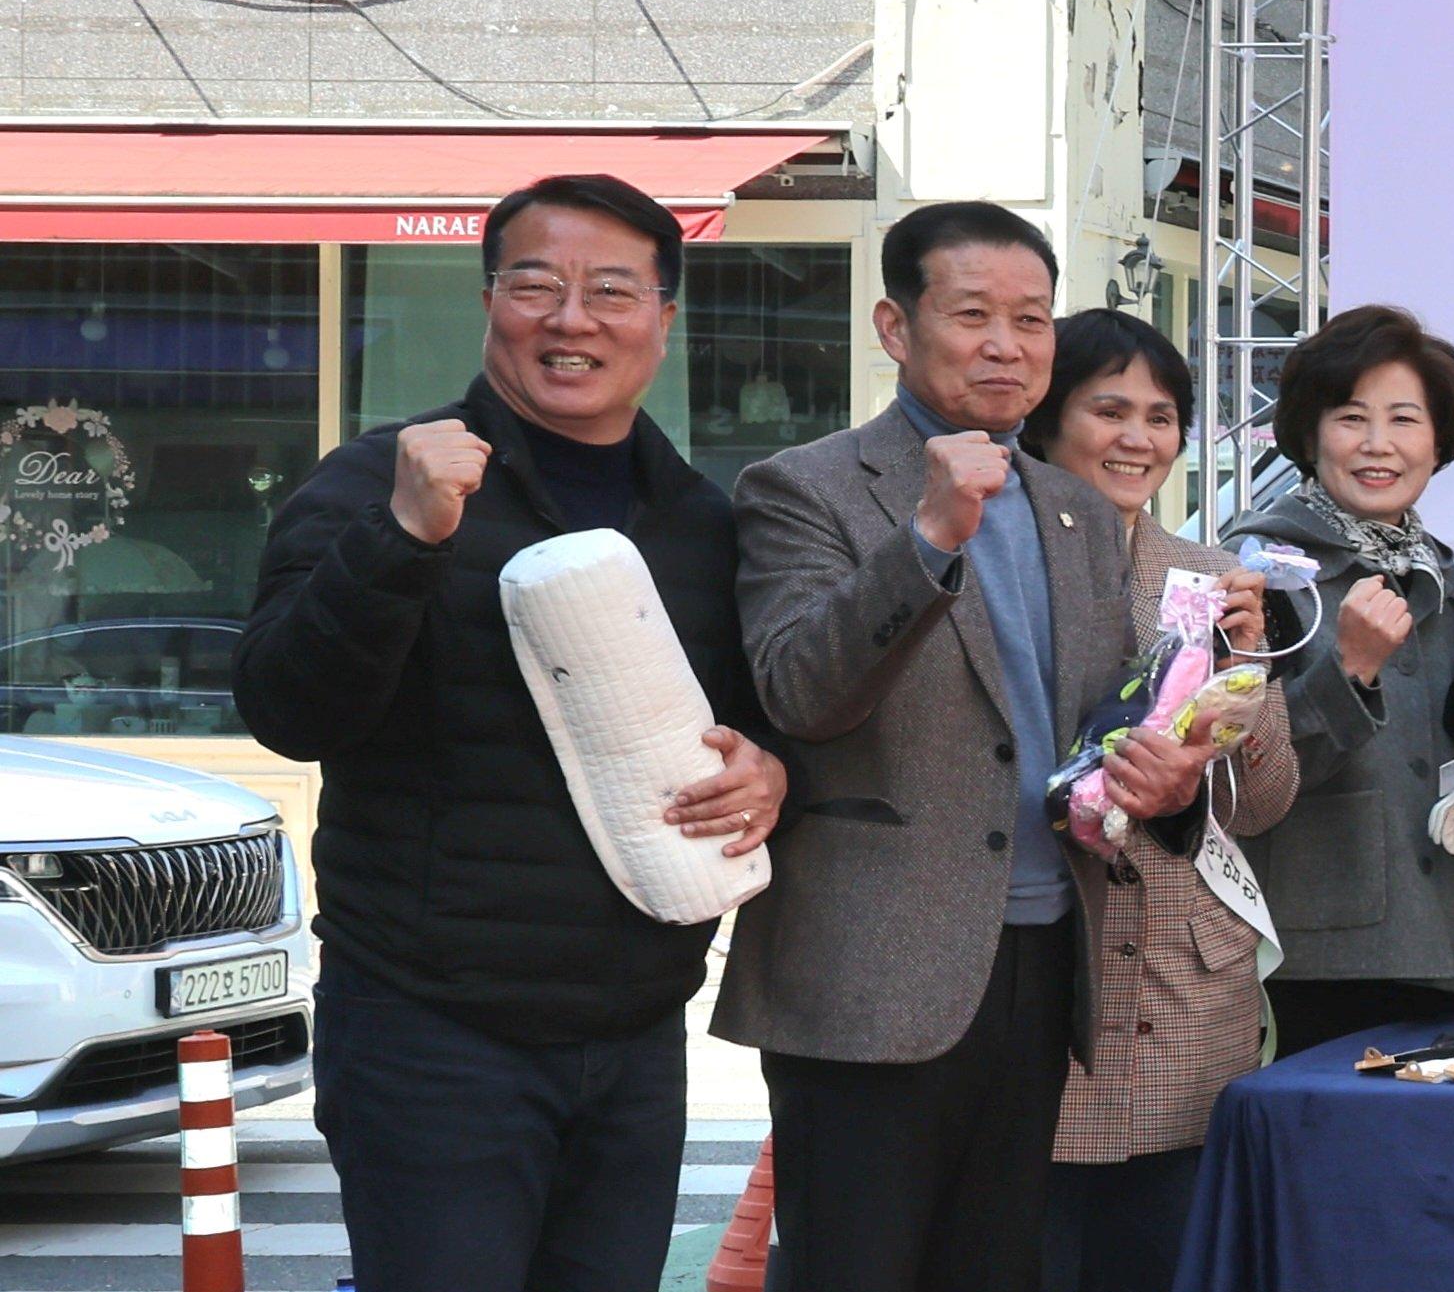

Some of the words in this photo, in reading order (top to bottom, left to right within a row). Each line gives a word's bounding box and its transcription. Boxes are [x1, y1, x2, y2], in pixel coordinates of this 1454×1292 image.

[396, 215, 480, 236] NARAE
[15, 451, 100, 485] Dear
[15, 489, 45, 501] Lovely
[47, 490, 73, 499] home
[75, 491, 99, 500] story
[185, 969, 234, 1007] 222호
[239, 958, 282, 997] 5700
